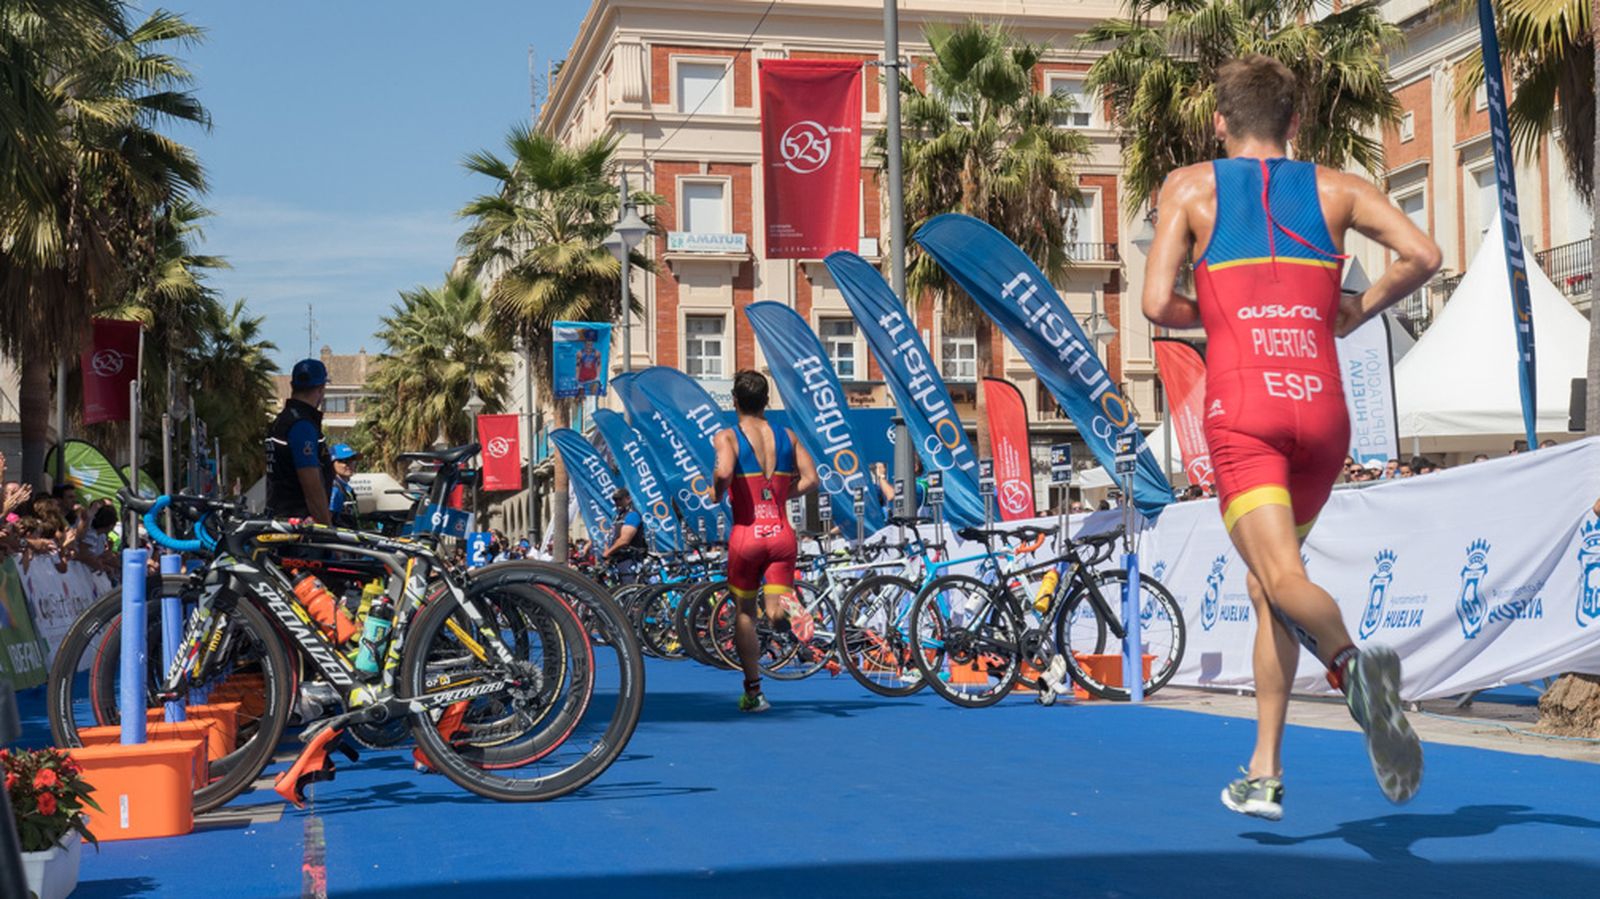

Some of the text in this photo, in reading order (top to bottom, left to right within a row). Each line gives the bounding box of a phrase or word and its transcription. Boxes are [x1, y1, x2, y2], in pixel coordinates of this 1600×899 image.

[686, 234, 744, 246] AMATUR
[1237, 304, 1322, 321] austral
[1251, 327, 1318, 358] PUERTAS
[1263, 371, 1323, 402] ESP
[432, 512, 450, 528] 61
[754, 524, 781, 539] ESP
[473, 541, 486, 563] 2
[1219, 604, 1250, 622] HUELVA
[1382, 608, 1424, 629] HUELVA
[249, 581, 354, 686] SPECIALIZED
[433, 680, 505, 704] SPECIALIZED
